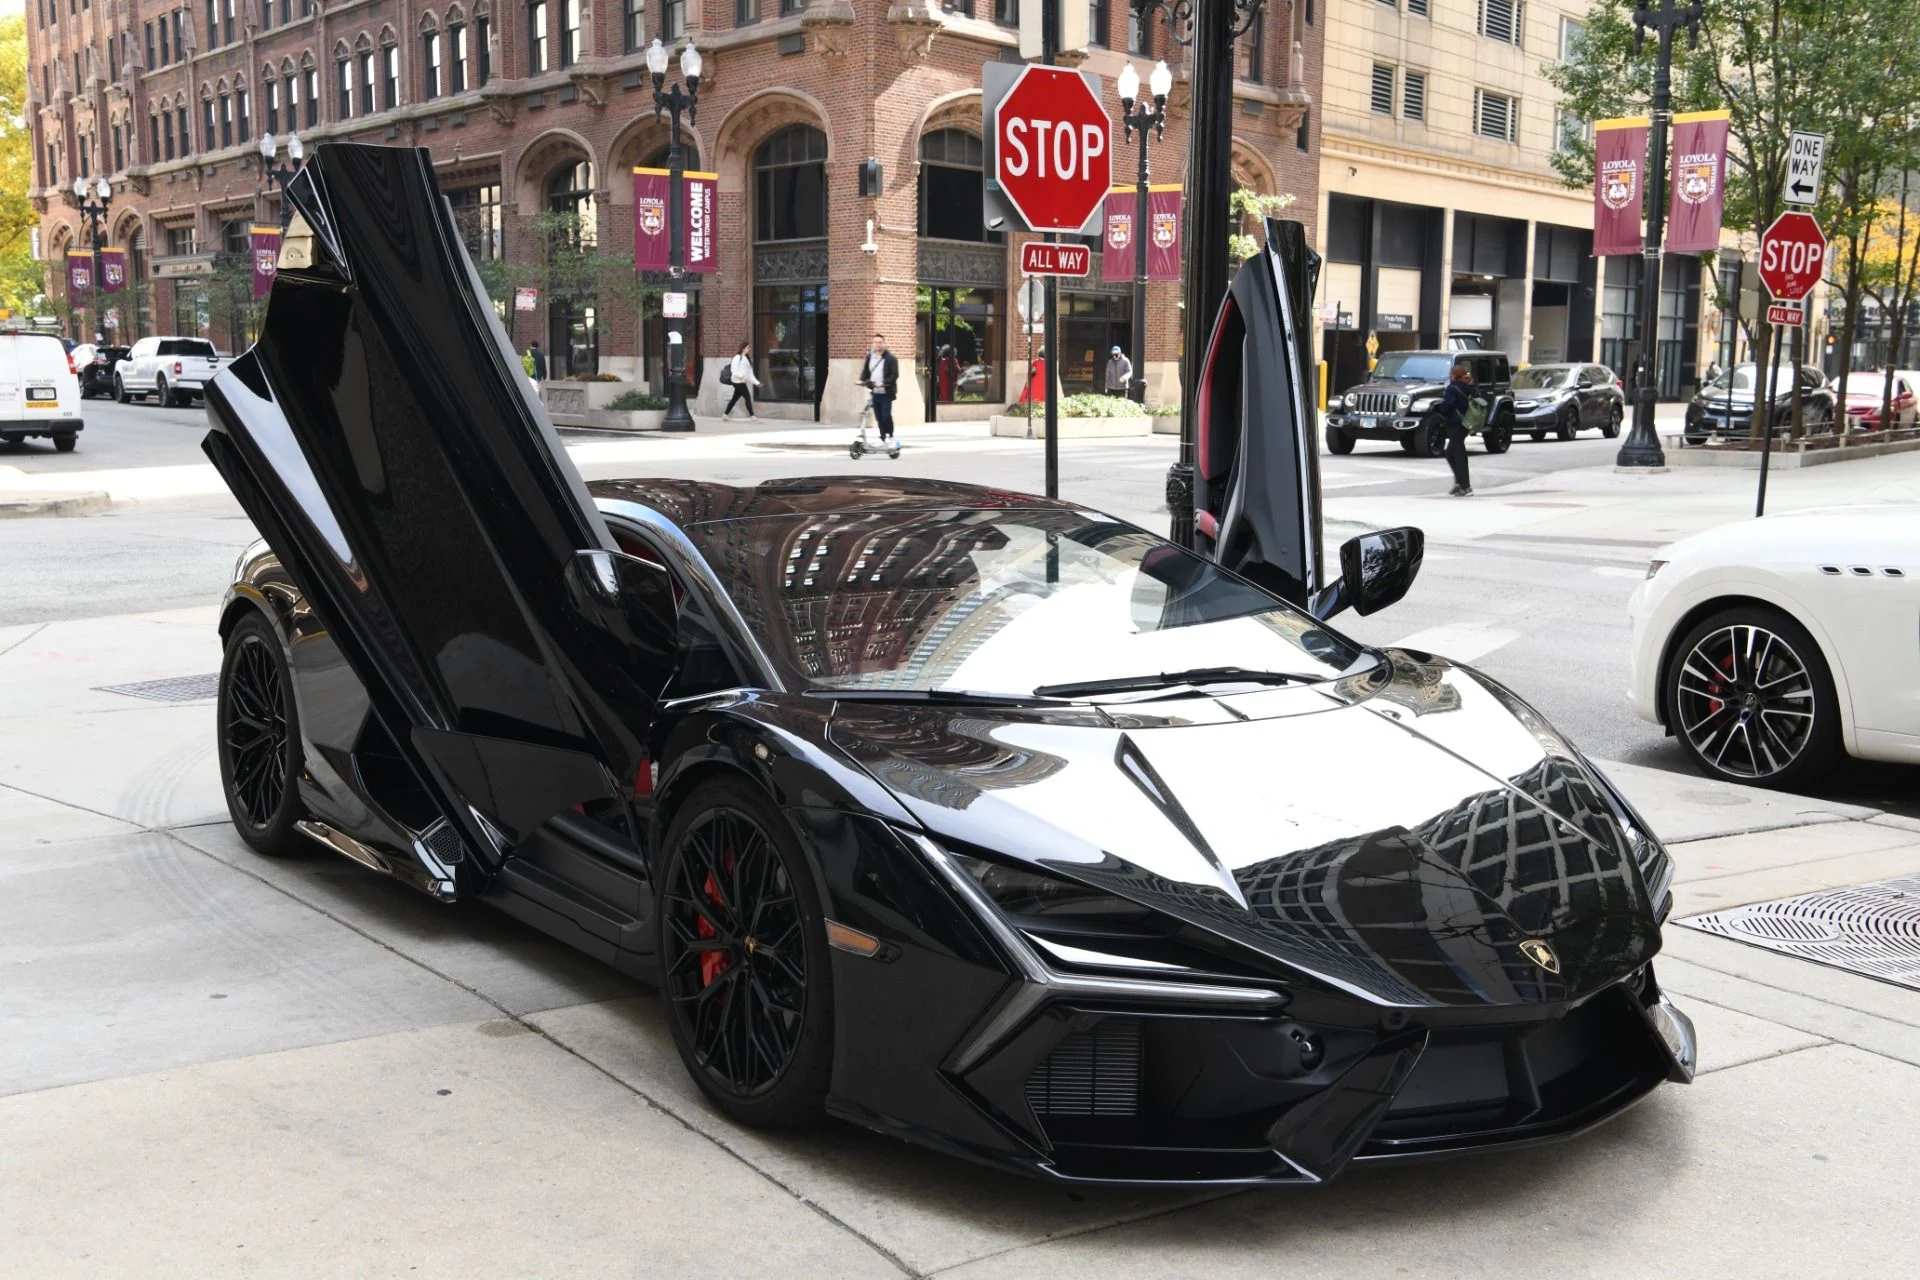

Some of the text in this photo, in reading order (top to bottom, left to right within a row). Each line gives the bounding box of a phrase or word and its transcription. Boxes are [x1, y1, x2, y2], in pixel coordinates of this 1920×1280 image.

[1005, 116, 1104, 181] STOP
[1794, 138, 1820, 157] ONE
[1602, 160, 1636, 170] LOYOLA
[1680, 153, 1718, 163] LOYOLA
[1791, 158, 1819, 177] WAY
[640, 197, 664, 205] LOYOLA
[690, 182, 703, 262] WELCOME
[1029, 249, 1083, 270] ALL WAY
[1763, 238, 1821, 275] STOP
[1770, 310, 1801, 323] ALL WAY
